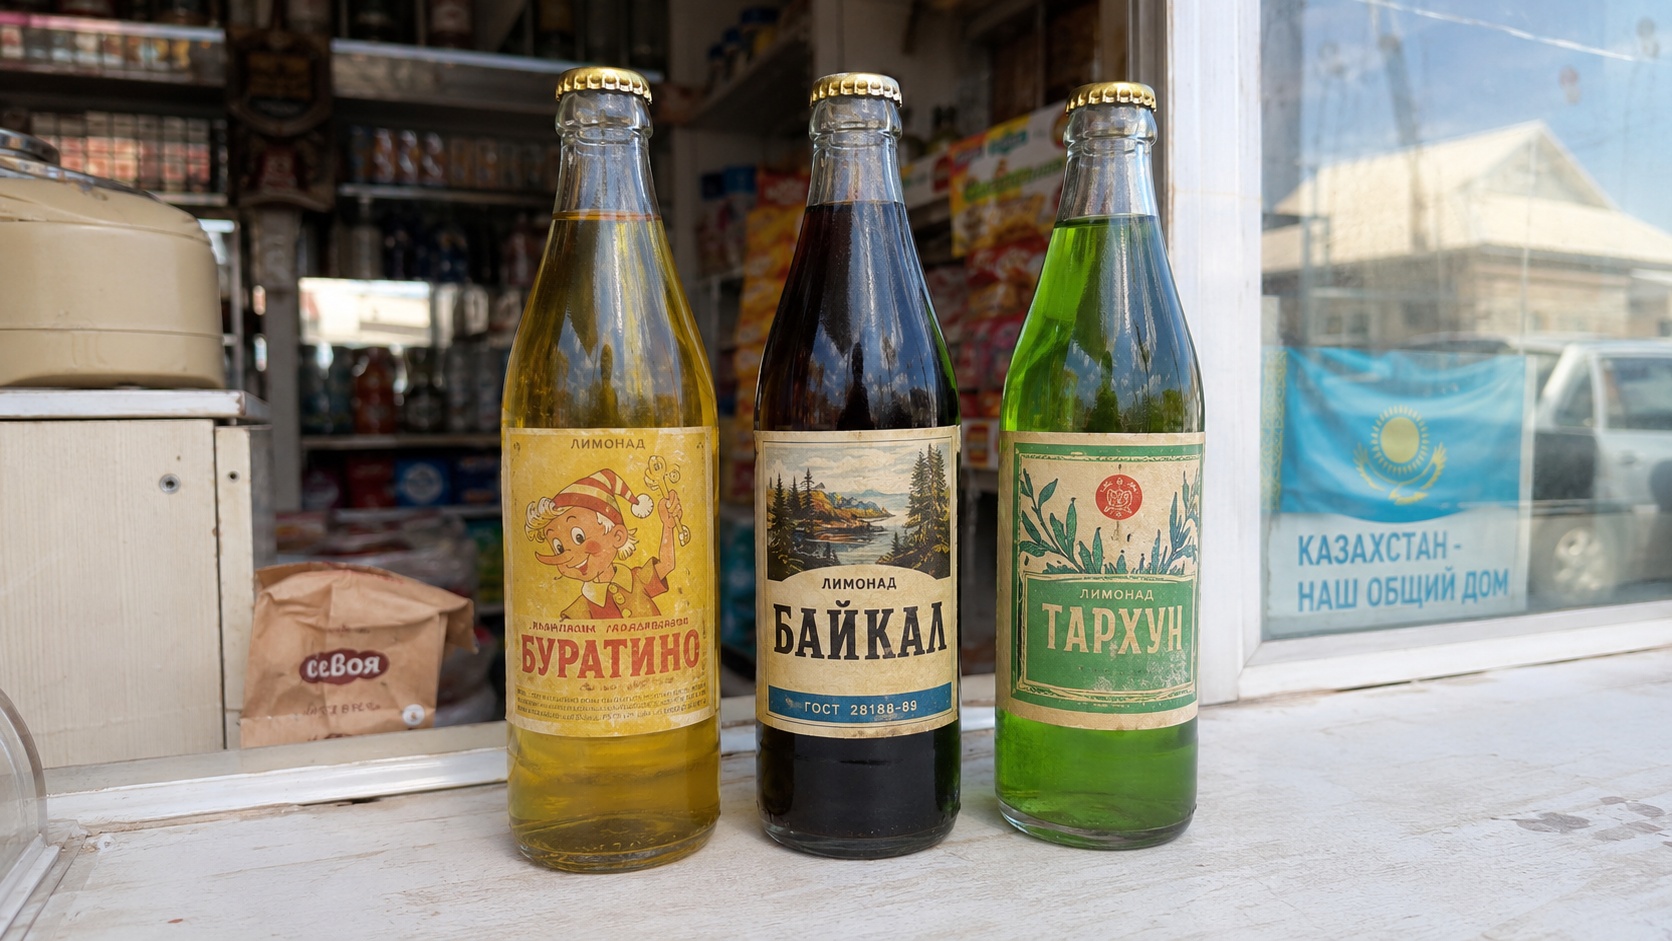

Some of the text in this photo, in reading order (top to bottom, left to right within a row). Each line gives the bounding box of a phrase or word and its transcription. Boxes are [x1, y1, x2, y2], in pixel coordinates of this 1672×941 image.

[570, 438, 646, 450] ЛИМОНАД
[1298, 531, 1448, 566] КАЗАХСТАН
[821, 577, 897, 590] ЛИМОНАД
[1079, 588, 1155, 601] ЛИМОНАД
[1298, 566, 1509, 612] НАШ ОБЩИЙ ДОМ
[773, 600, 947, 660] БАЙКАЛ
[1042, 603, 1183, 655] ТАРХУН
[521, 629, 700, 679] БУРАТИНО
[804, 699, 918, 716] ГОСТ 28188-89
